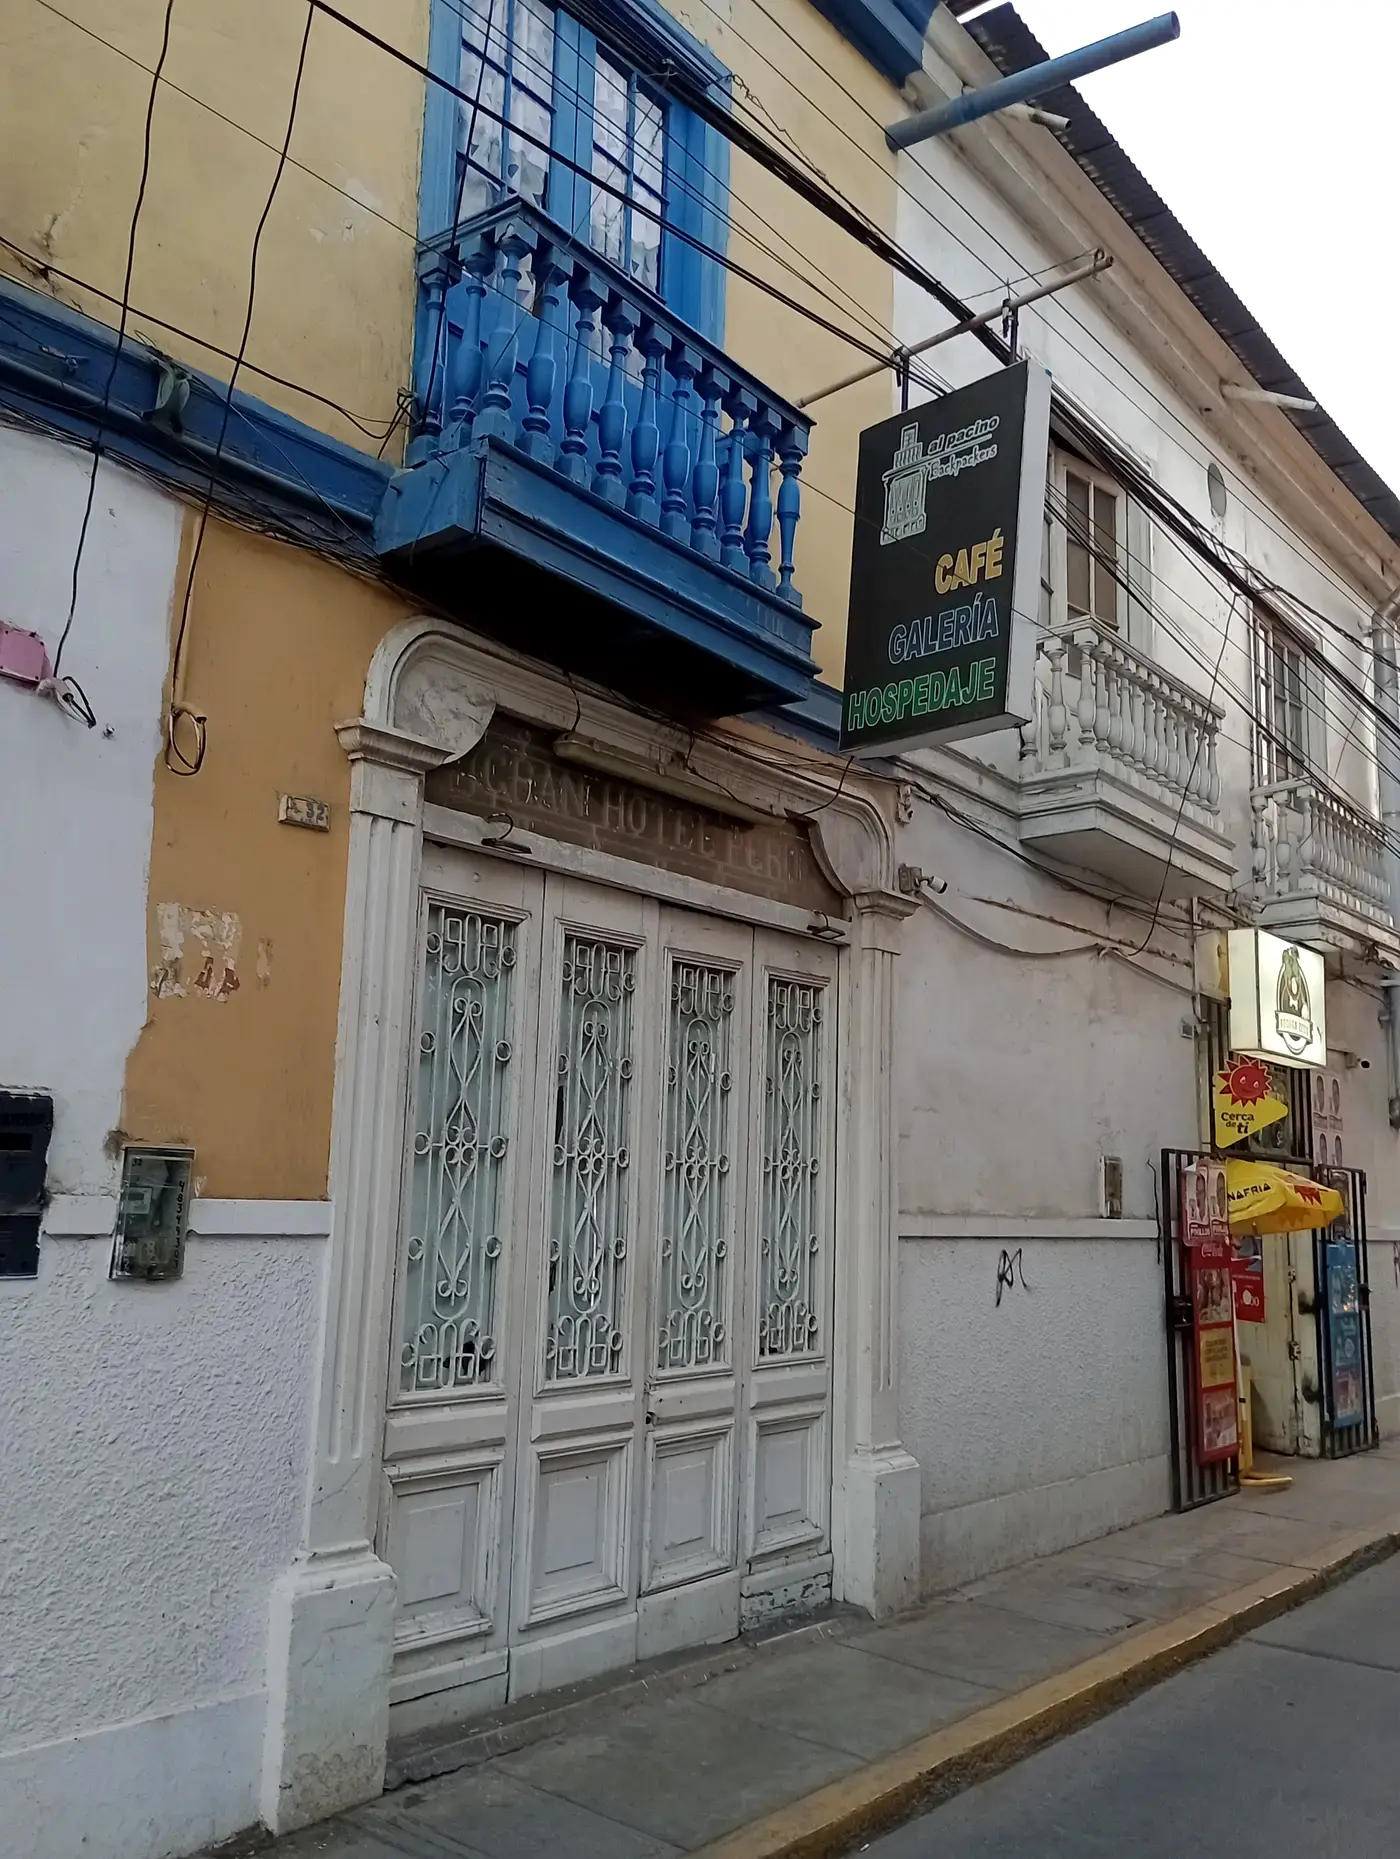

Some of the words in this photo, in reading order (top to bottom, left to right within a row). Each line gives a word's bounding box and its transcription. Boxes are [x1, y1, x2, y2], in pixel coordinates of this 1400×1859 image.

[947, 413, 1000, 446] pacino
[934, 527, 1004, 596] CAFÉ
[888, 592, 999, 665] GALERÍA
[847, 656, 996, 732] HOSPEDAJE
[602, 784, 715, 858] HOTEL
[1220, 1111, 1255, 1122] Cerca
[1225, 1120, 1237, 1128] de
[1236, 1121, 1250, 1134] ti
